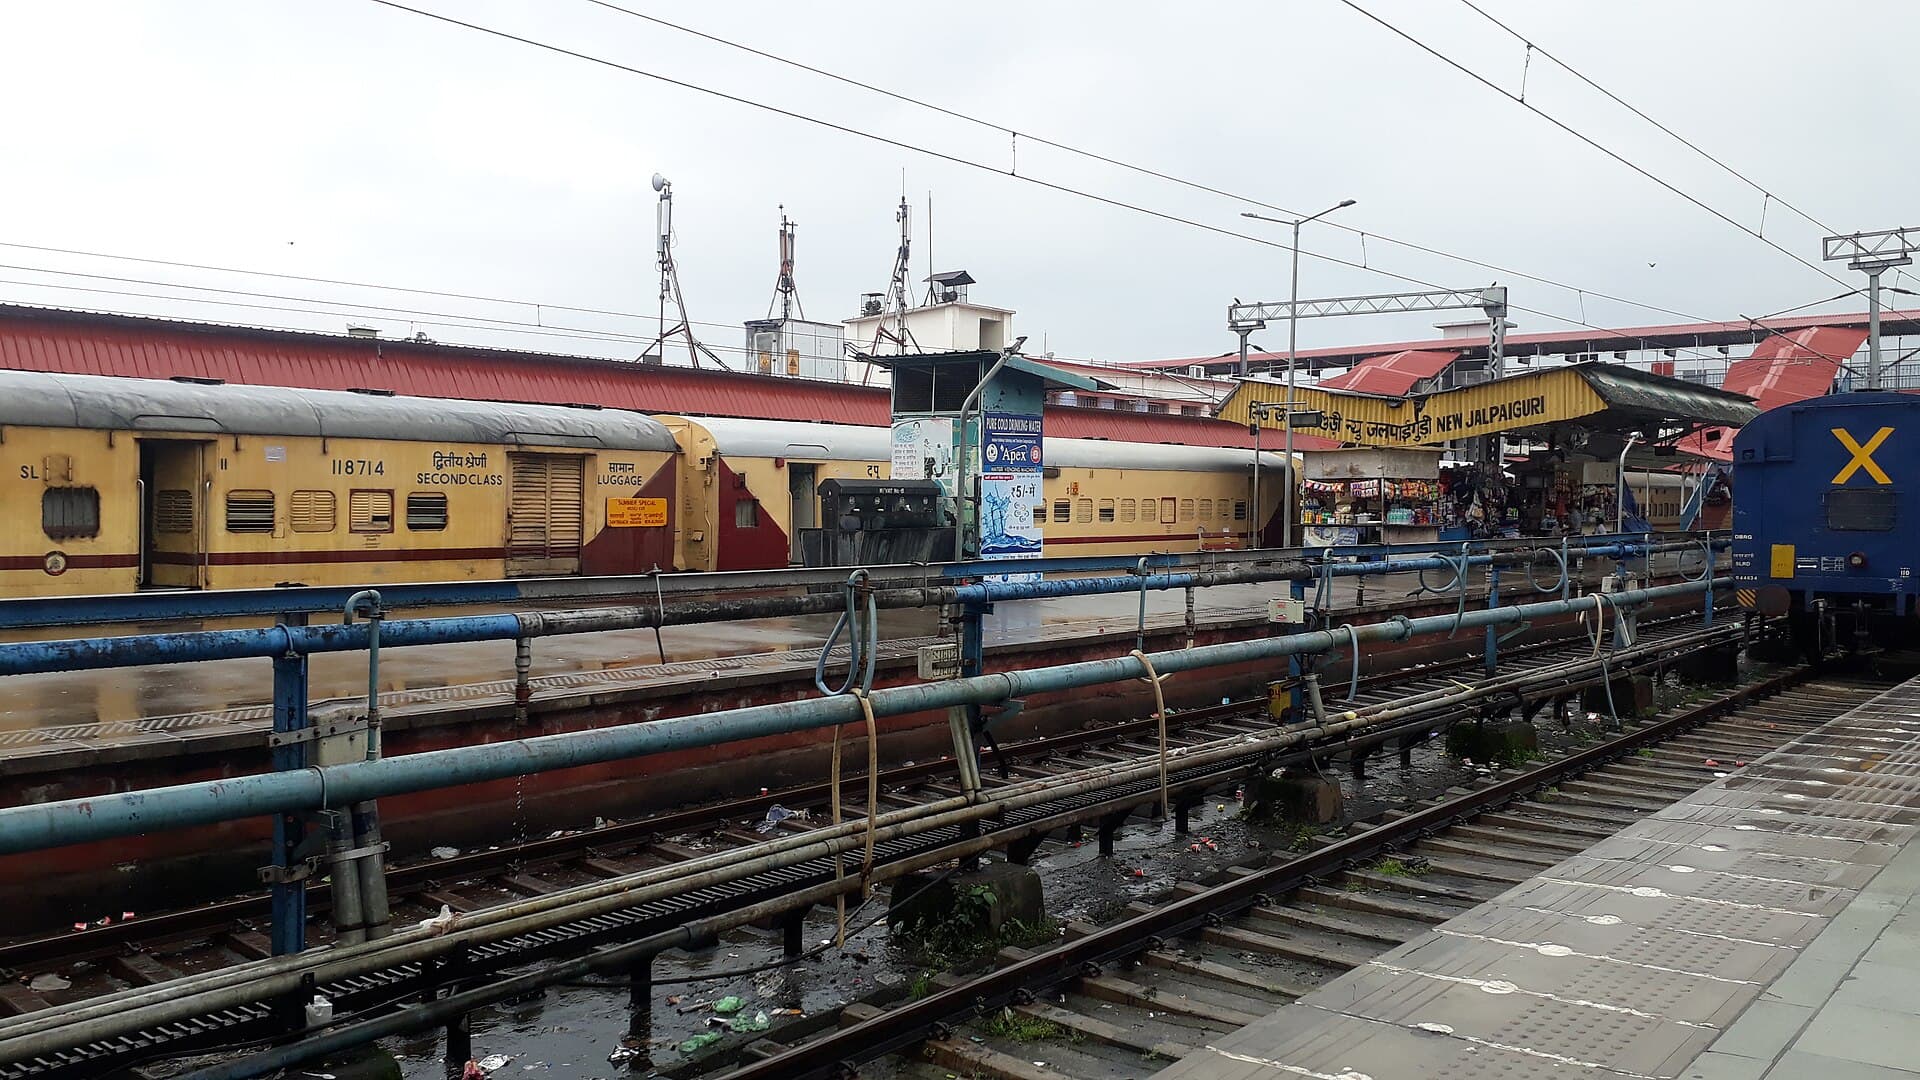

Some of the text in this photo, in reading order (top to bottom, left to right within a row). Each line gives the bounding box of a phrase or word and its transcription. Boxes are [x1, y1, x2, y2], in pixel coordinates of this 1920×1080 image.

[1436, 395, 1545, 433] NEW JALPAIGURI
[986, 417, 1041, 432] PURE COLD DRINKING WATER
[433, 450, 487, 470] द्वितीय श्रेणी
[1002, 447, 1027, 464] Apex
[1831, 426, 1896, 485] X
[20, 465, 40, 479] SL
[332, 459, 385, 476] 118714
[608, 462, 635, 473] सामान
[597, 474, 642, 486] LUGGAGE
